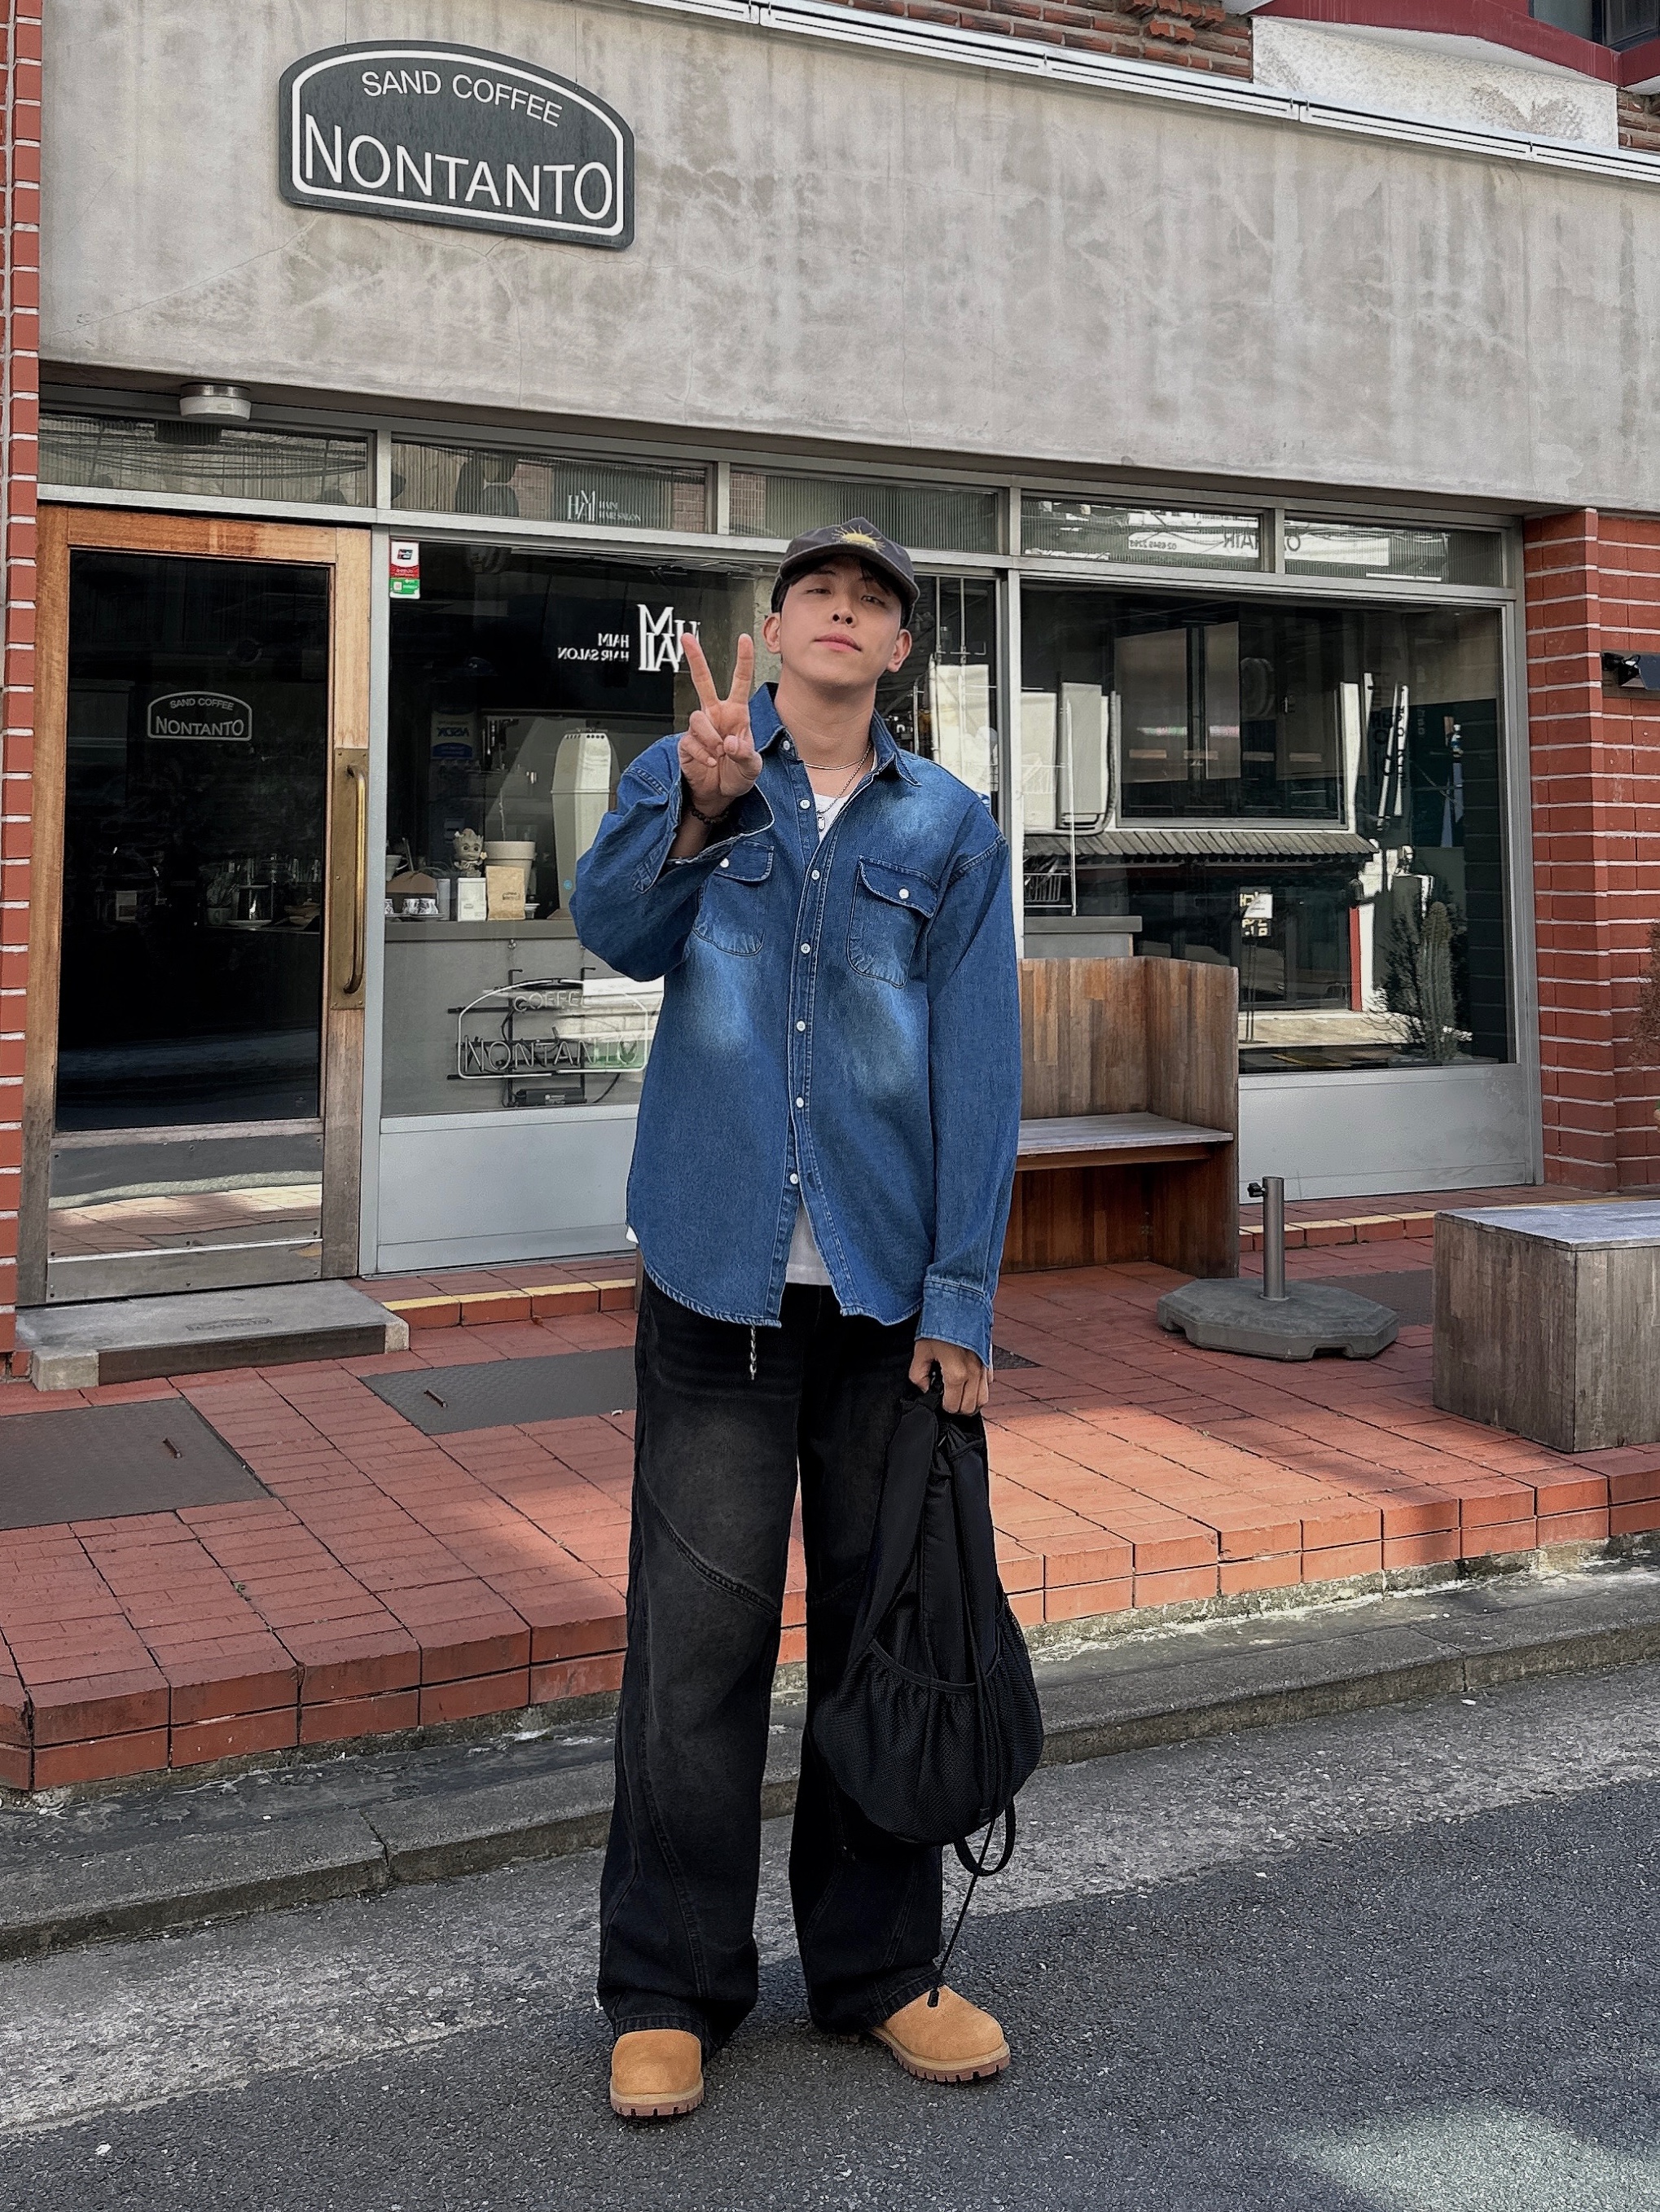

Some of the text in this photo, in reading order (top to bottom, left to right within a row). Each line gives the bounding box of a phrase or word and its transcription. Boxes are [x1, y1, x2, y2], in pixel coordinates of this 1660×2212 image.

[362, 70, 563, 127] SAND COFFEE
[305, 113, 613, 221] NONTANTO
[169, 697, 235, 711] SAND COFFEE
[156, 716, 244, 737] NONTANTO
